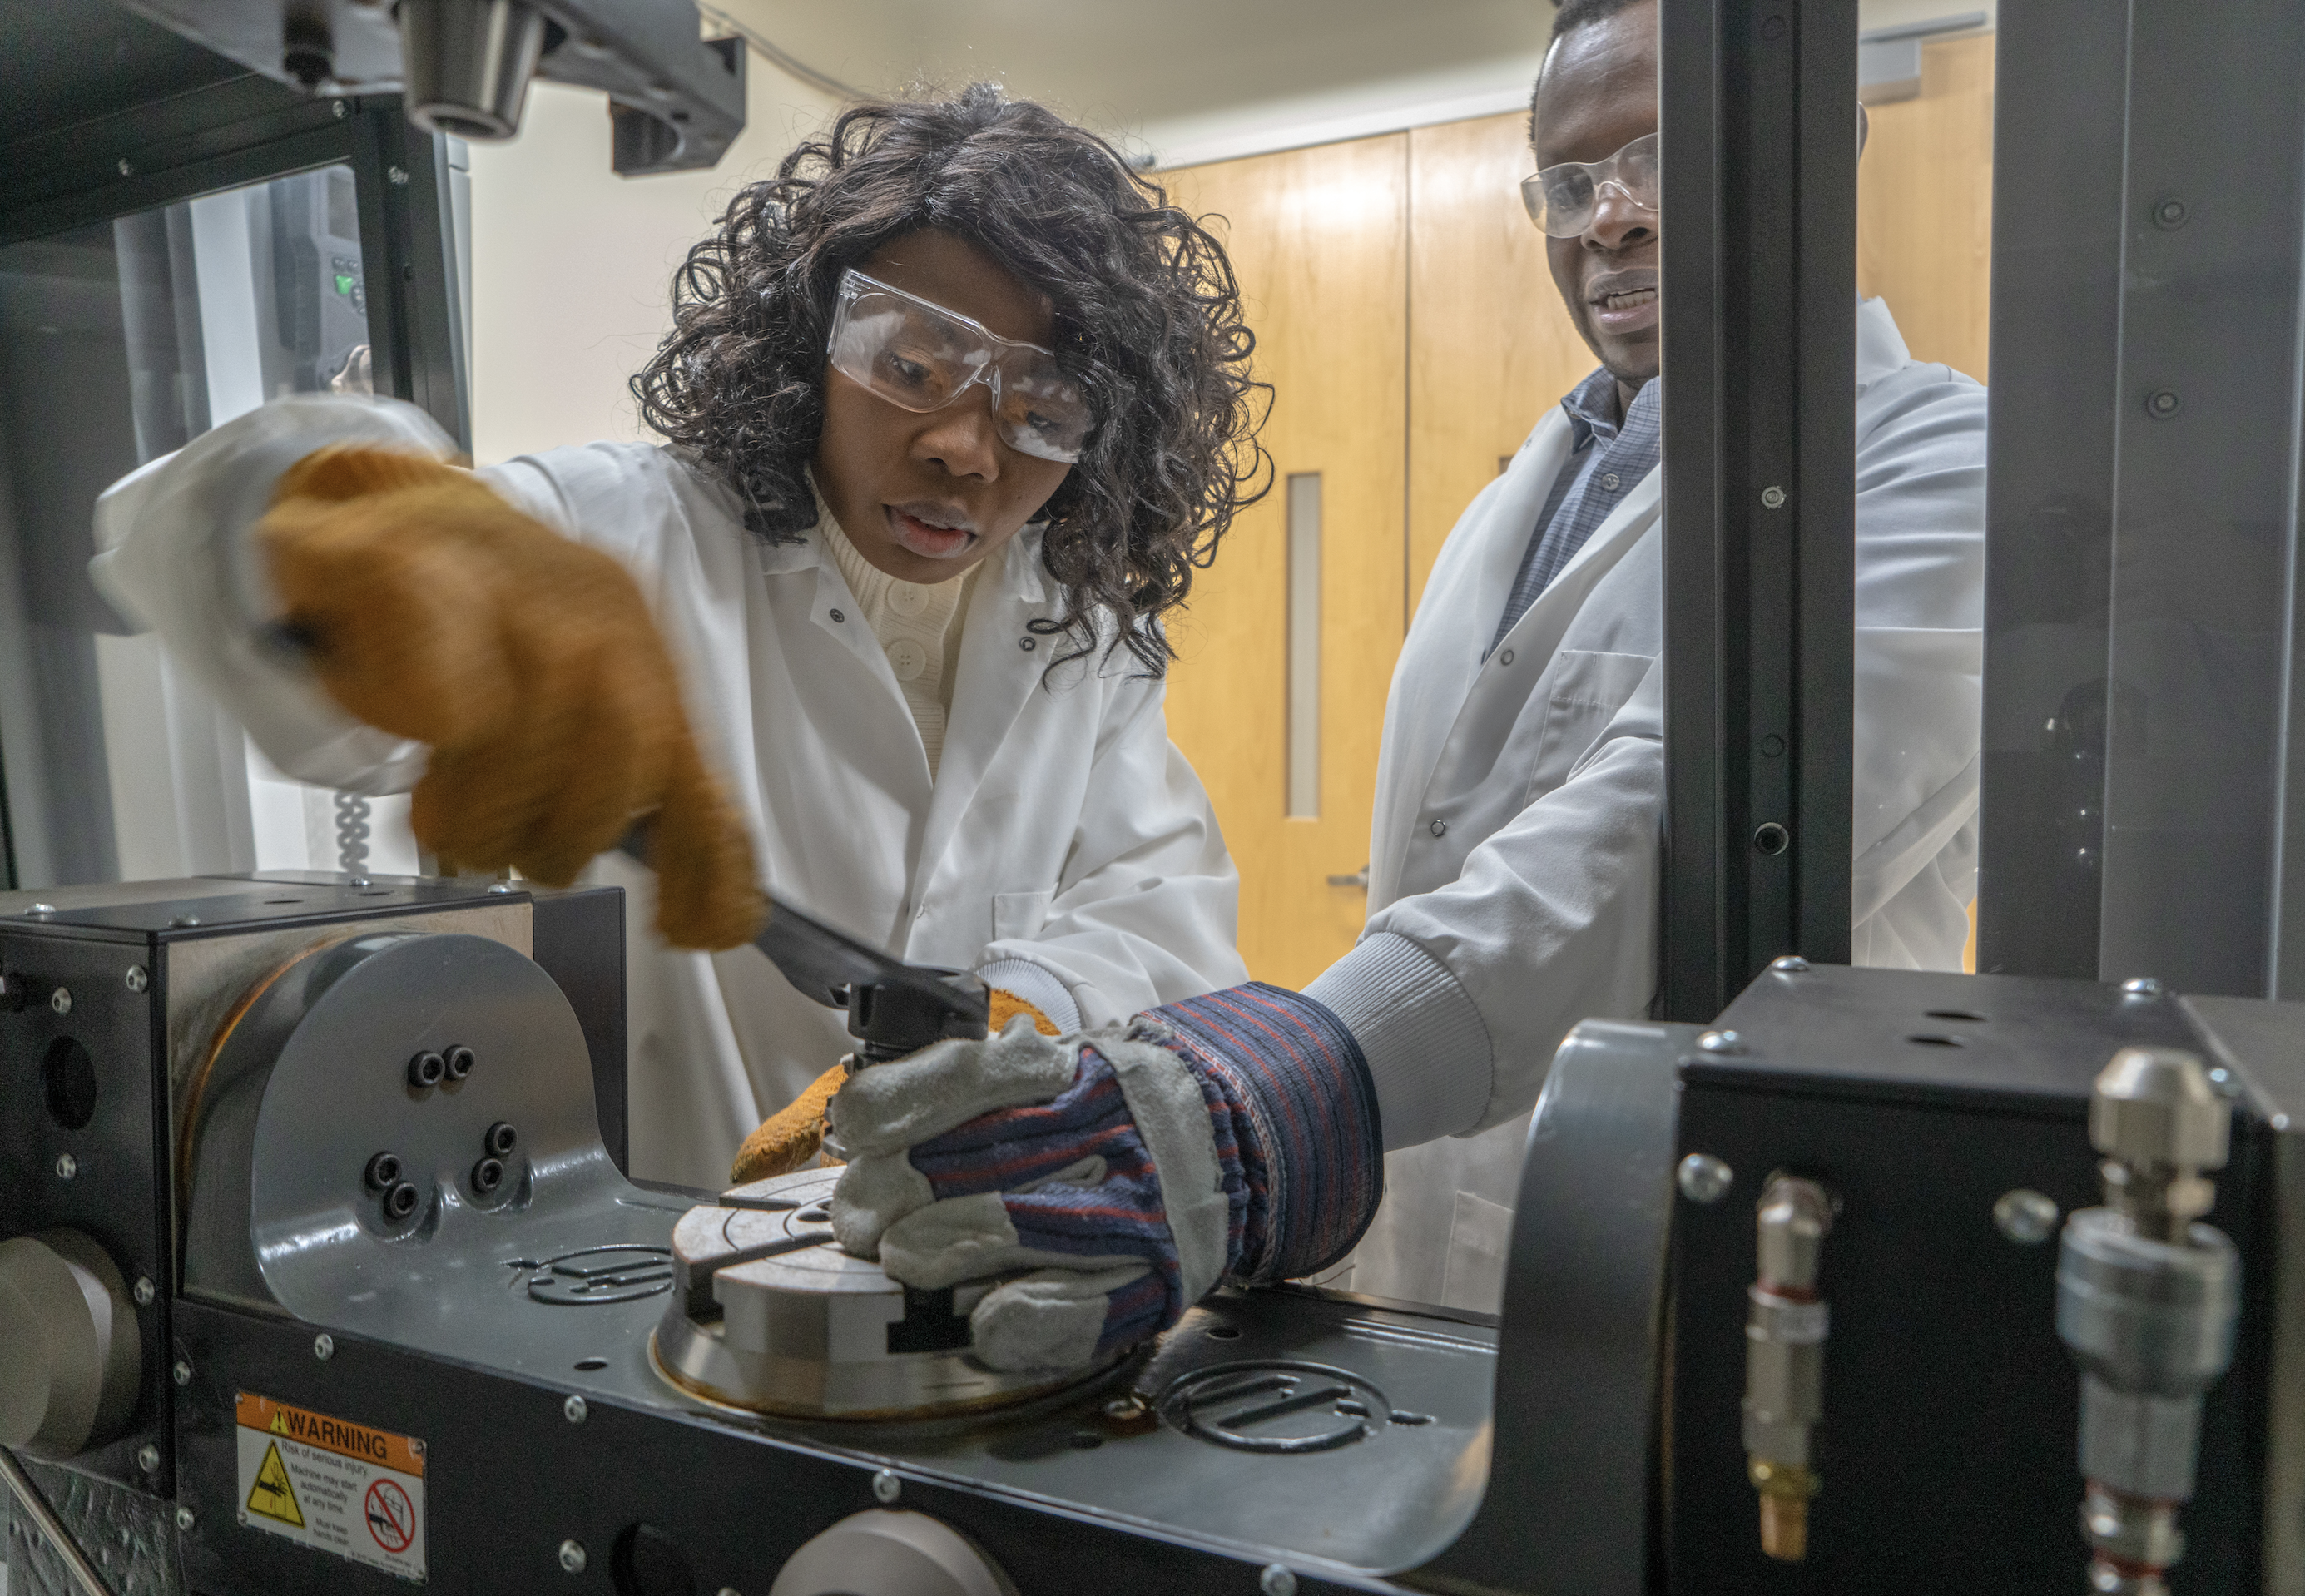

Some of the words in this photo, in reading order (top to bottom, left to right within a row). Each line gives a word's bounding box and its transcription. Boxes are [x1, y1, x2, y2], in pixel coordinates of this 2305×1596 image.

[288, 1410, 387, 1460] WARNING
[281, 1440, 300, 1455] Risk
[302, 1447, 310, 1459] of
[312, 1451, 342, 1469] serious
[290, 1461, 321, 1481] Machine
[323, 1474, 339, 1488] may
